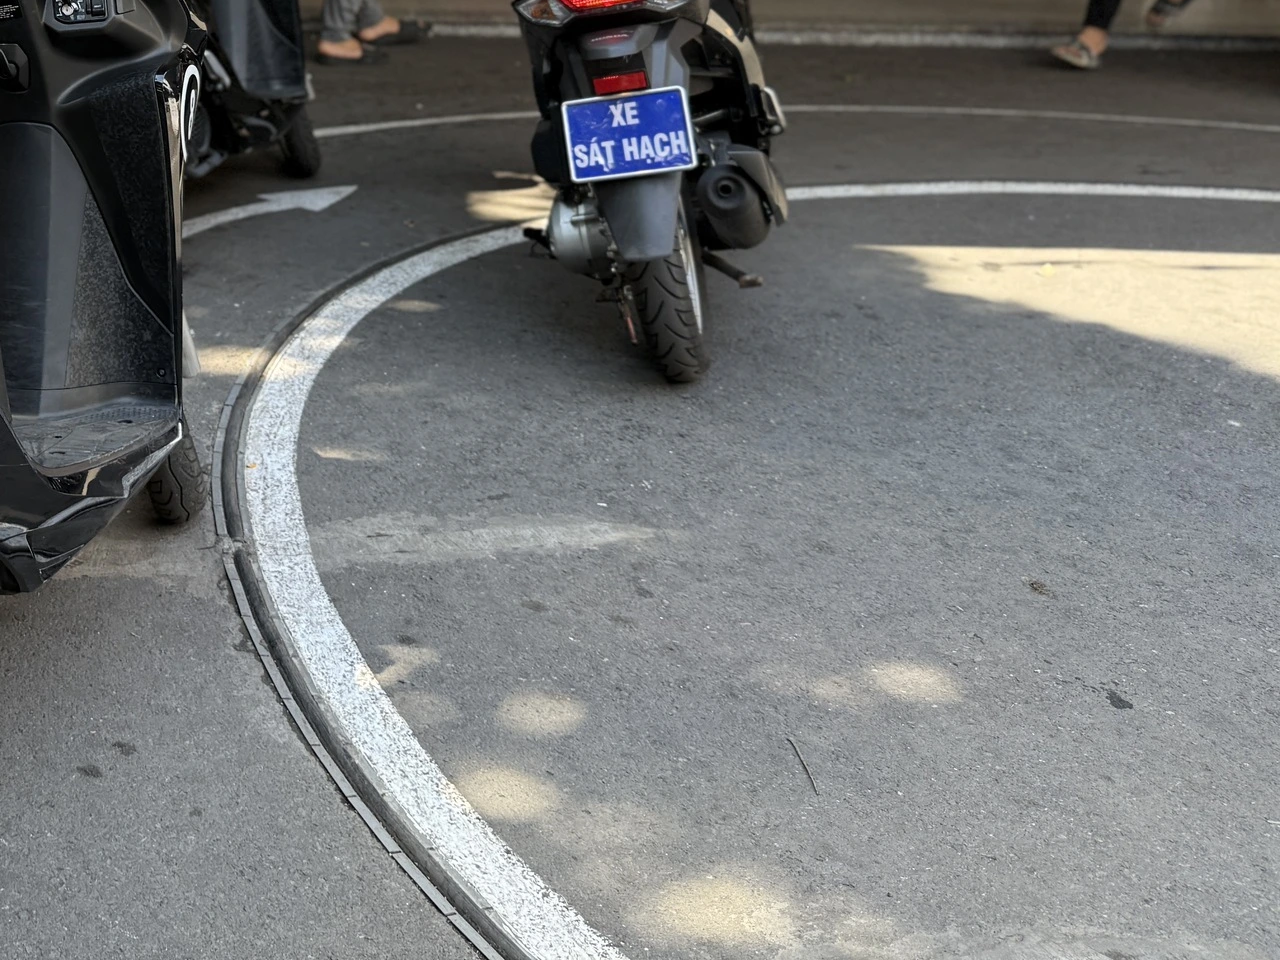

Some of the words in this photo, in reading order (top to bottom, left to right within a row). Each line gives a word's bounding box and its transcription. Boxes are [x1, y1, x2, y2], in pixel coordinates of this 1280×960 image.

[609, 101, 640, 128] XE
[573, 136, 616, 169] SÁT
[621, 130, 689, 165] HẠCH
